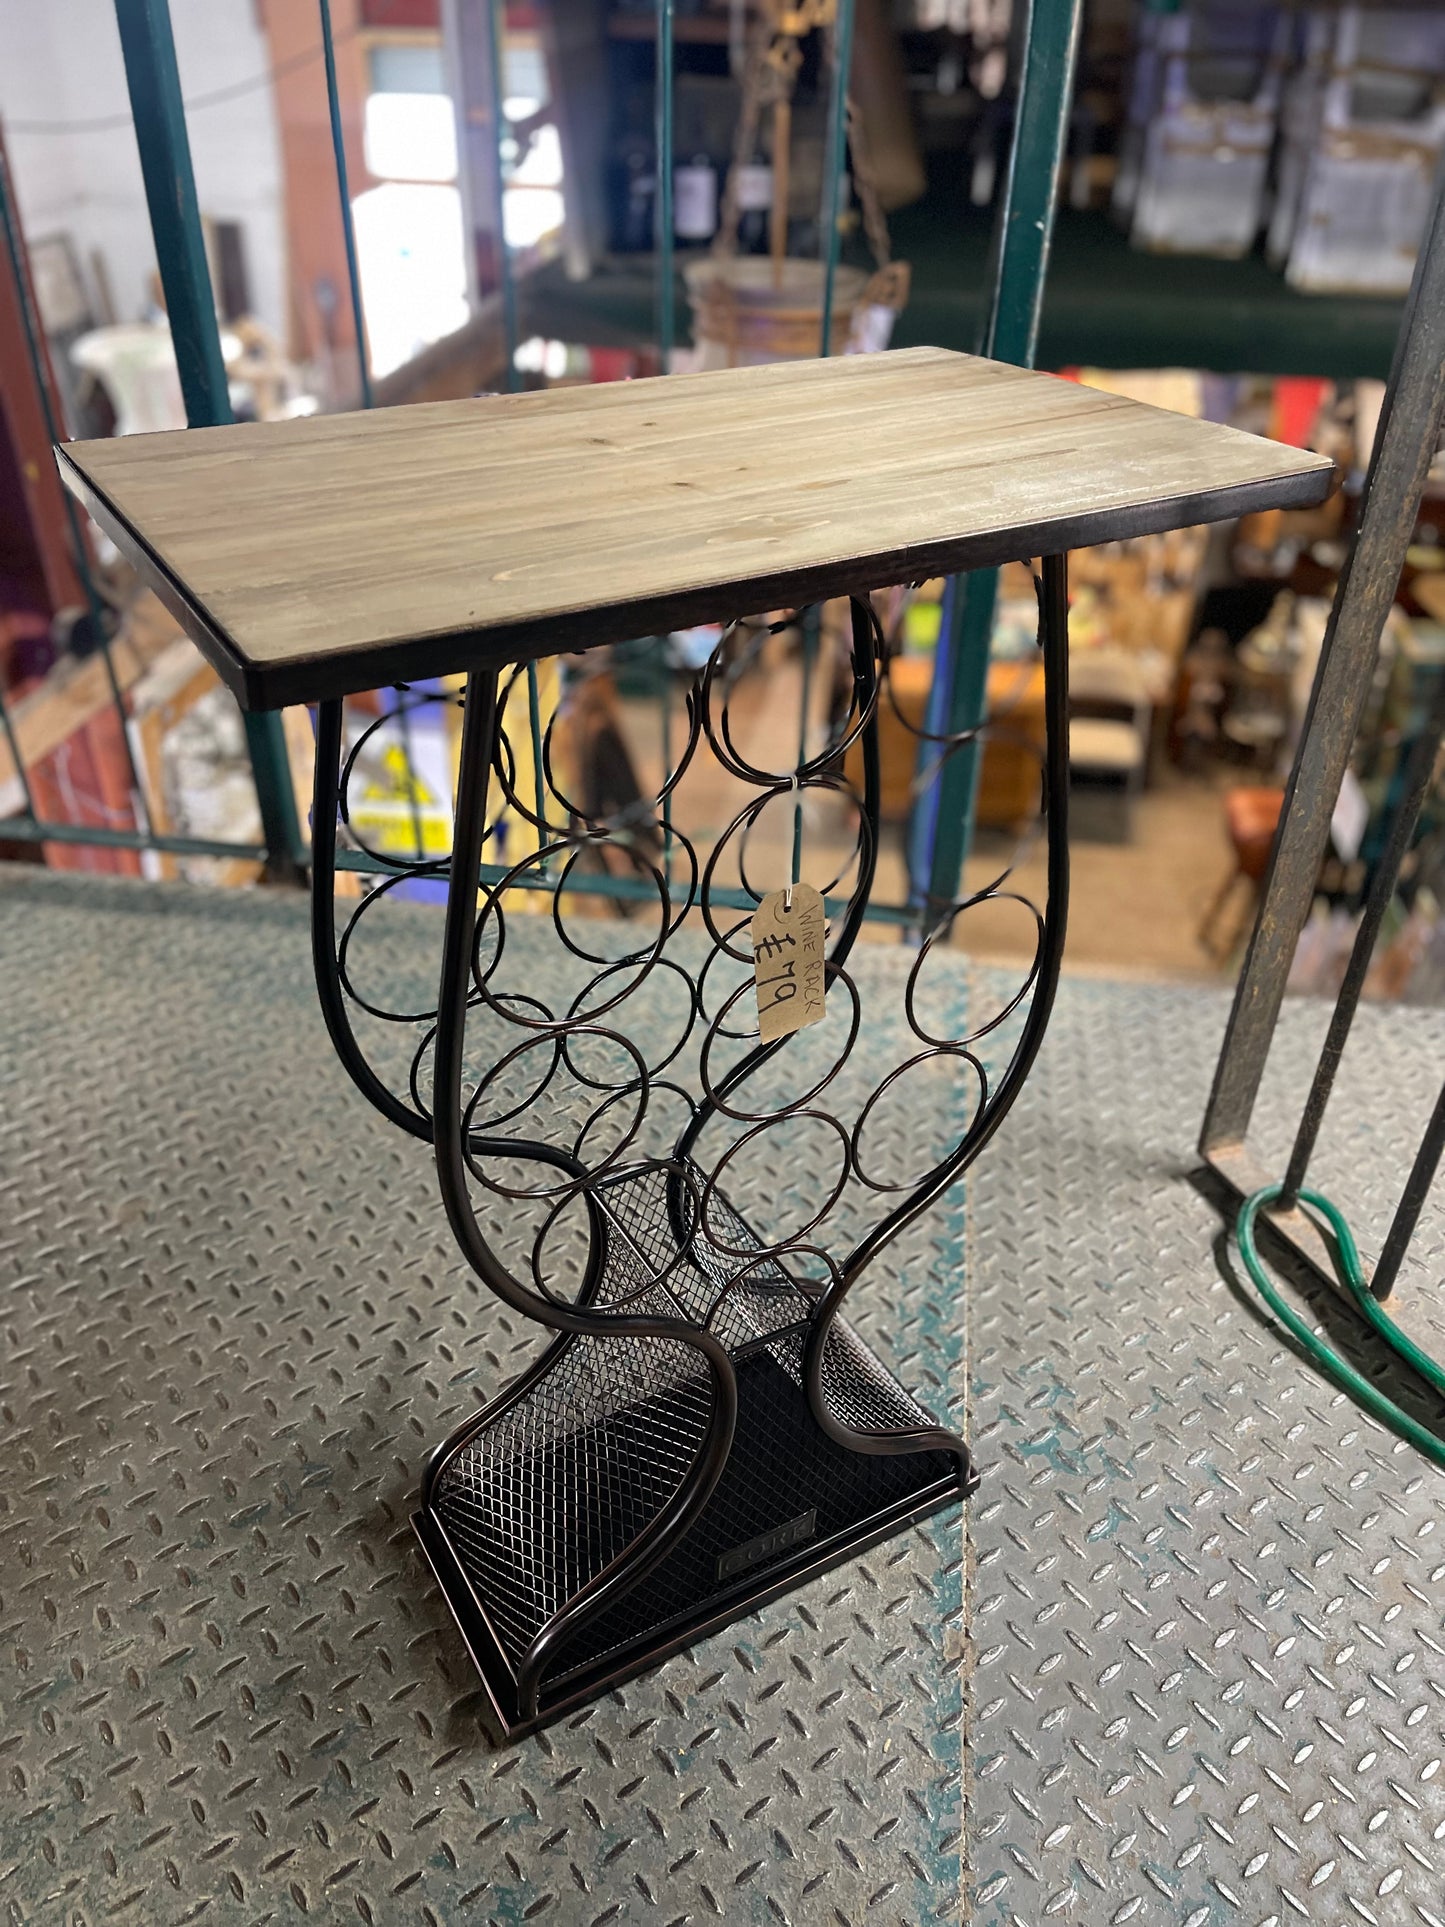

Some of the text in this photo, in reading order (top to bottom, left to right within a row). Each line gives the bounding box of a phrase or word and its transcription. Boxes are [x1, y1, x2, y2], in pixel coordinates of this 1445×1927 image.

[754, 933, 797, 1014] £79
[798, 904, 822, 1014] WINE RACK
